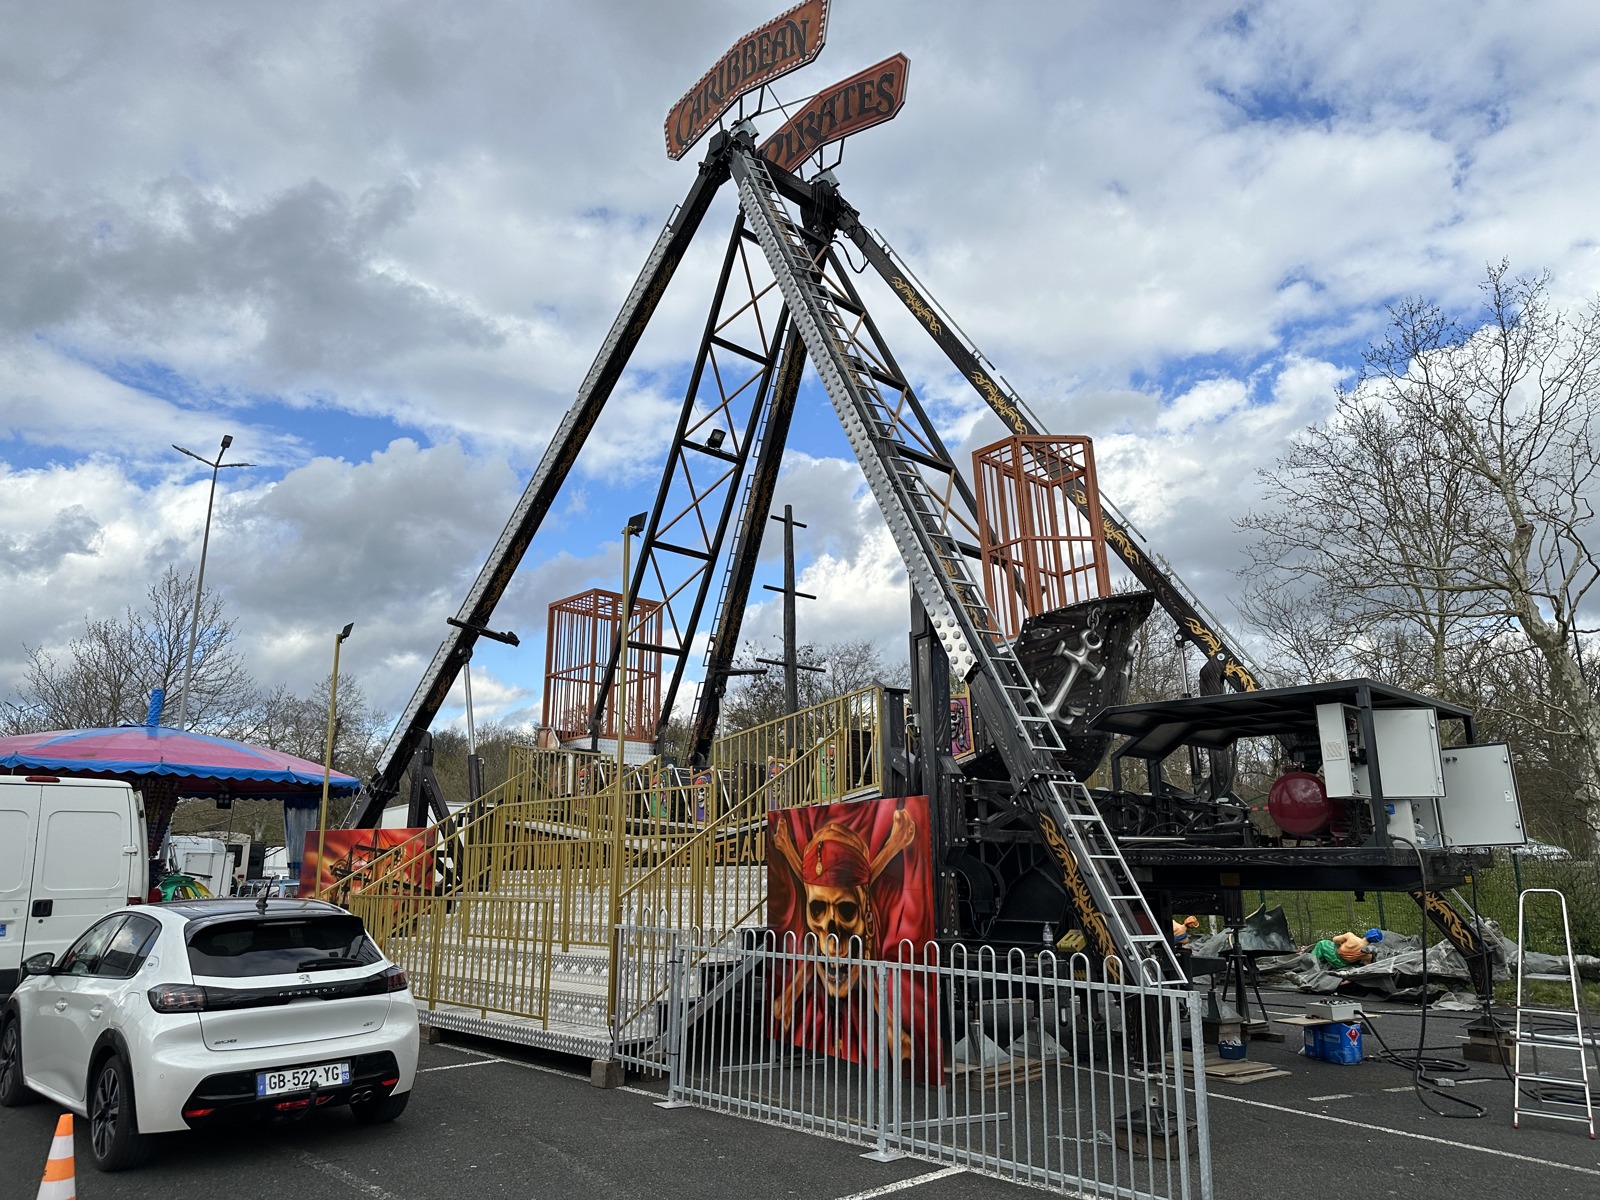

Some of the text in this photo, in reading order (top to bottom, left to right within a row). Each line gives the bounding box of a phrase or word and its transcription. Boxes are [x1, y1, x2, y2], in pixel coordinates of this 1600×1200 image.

[676, 19, 810, 146] CARIBBEAN
[762, 72, 896, 164] PIRATES
[279, 986, 336, 997] PEUGEOT
[214, 1038, 238, 1046] 208
[268, 1066, 340, 1090] GB-522-YG
